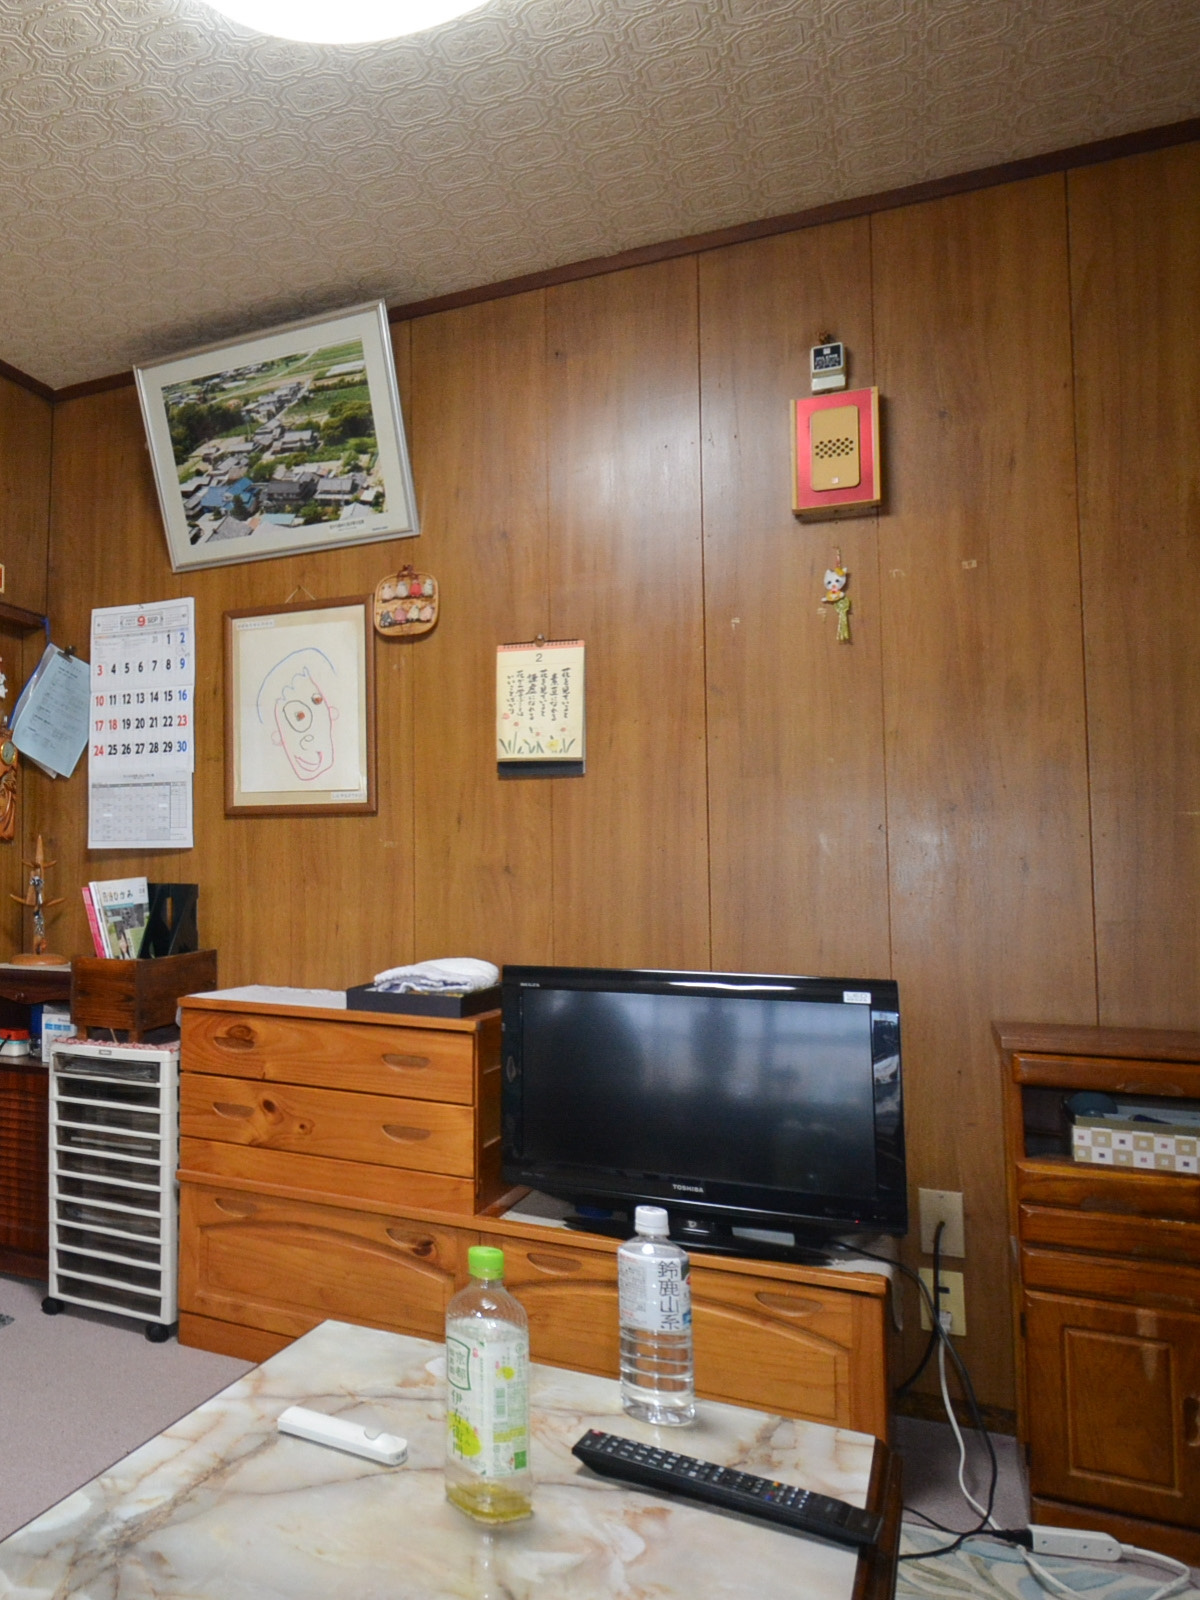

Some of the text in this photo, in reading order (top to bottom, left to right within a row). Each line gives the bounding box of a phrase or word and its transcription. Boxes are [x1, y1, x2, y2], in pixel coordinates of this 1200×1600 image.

[137, 615, 146, 627] 9
[147, 616, 159, 624] SEP
[166, 633, 171, 645] 1
[180, 632, 185, 643] 2
[535, 653, 543, 663] 2
[97, 658, 185, 676] 3 4 5 6 7 8 9
[95, 689, 188, 706] 10 11 12 13 14 15 16
[95, 714, 188, 731] 17 18 19 20 21 22 23
[94, 740, 187, 756] 24 25 26 27 28 29 30
[672, 1183, 705, 1194] TOSHIBA
[658, 1260, 680, 1331] 鈴鹿山系
